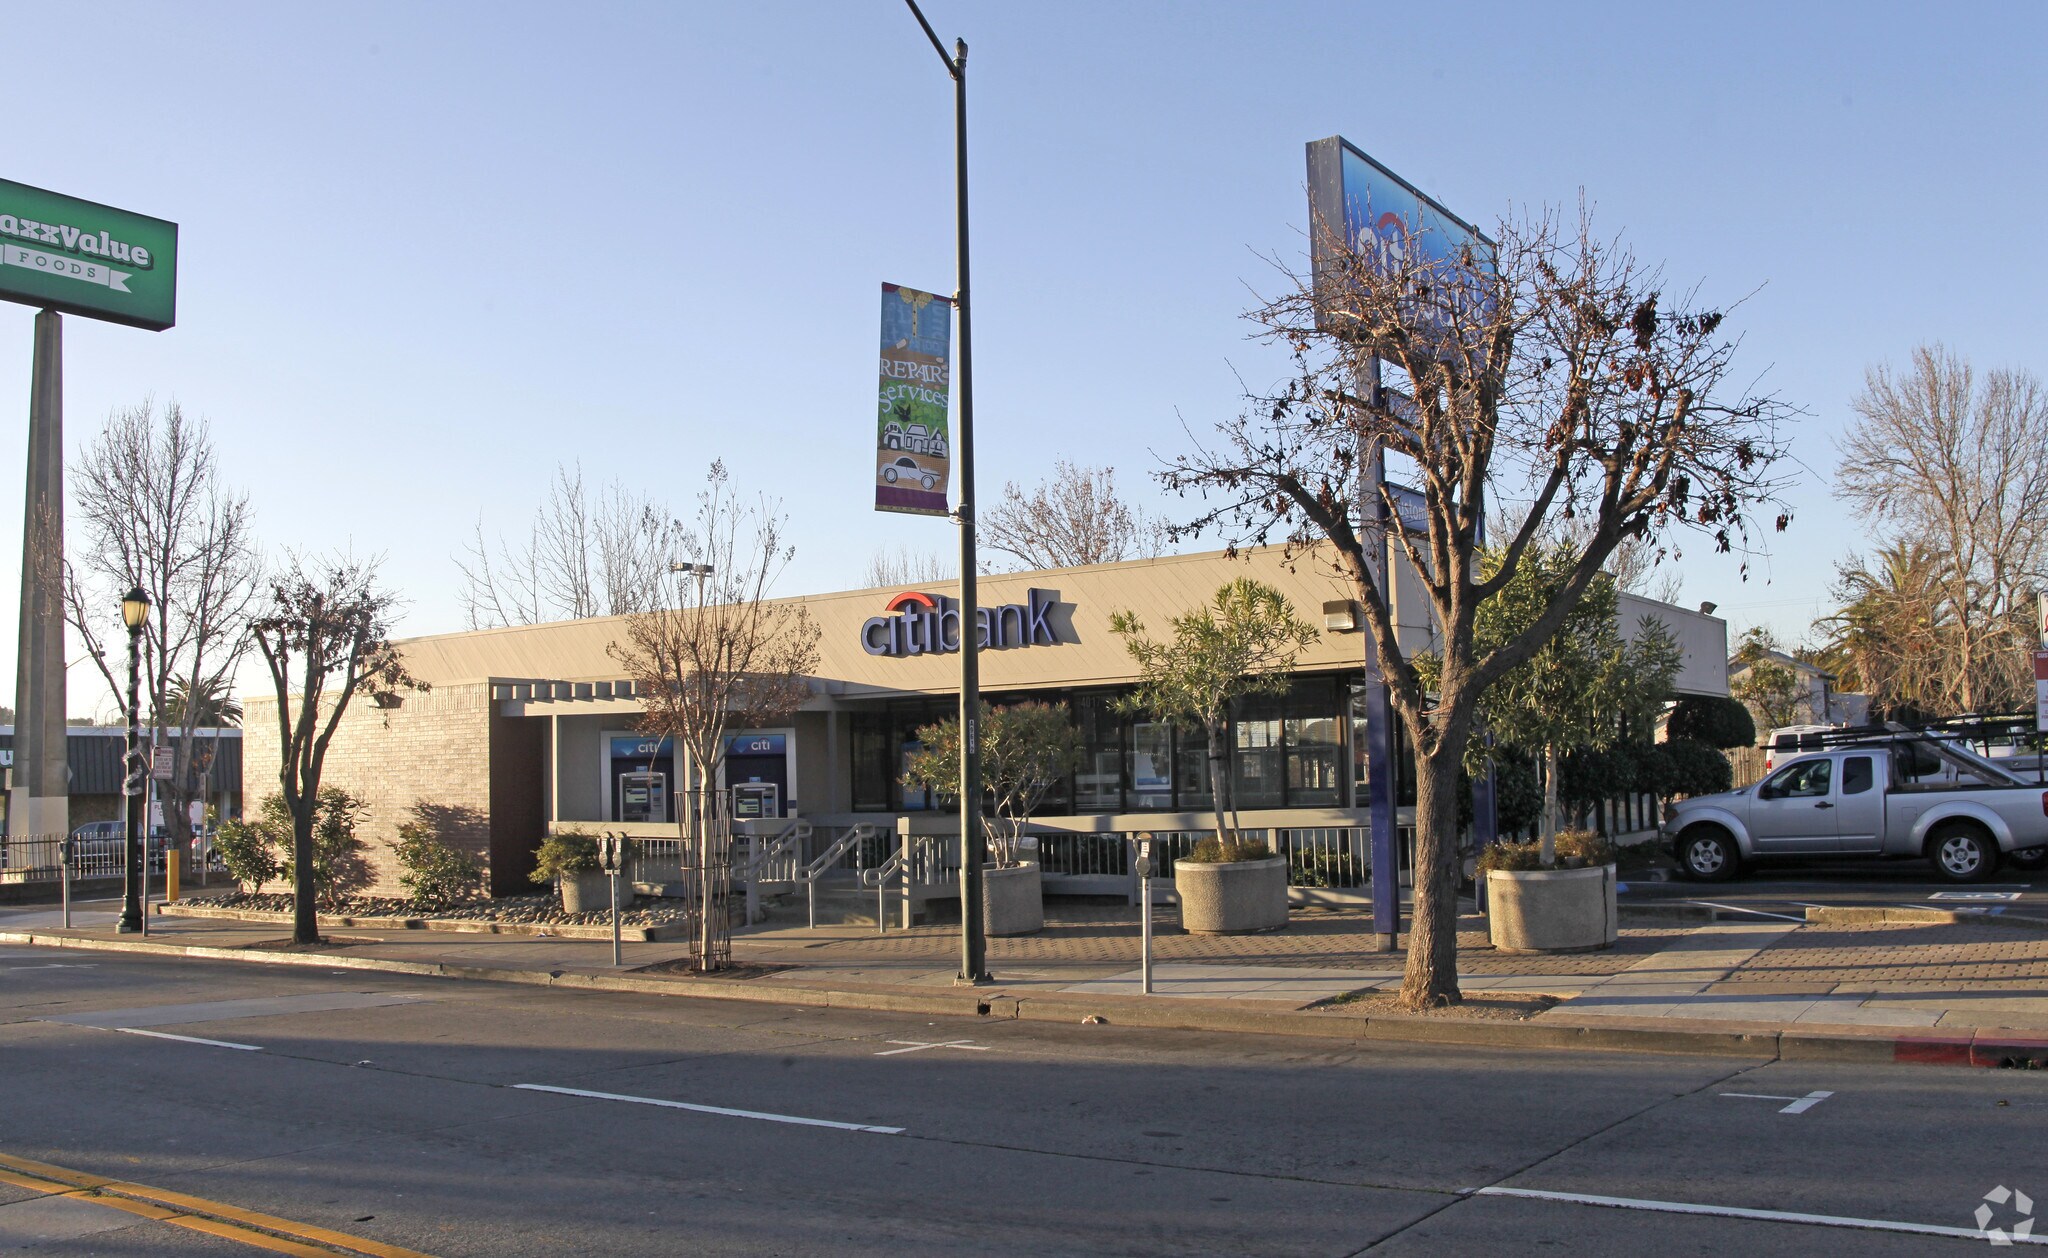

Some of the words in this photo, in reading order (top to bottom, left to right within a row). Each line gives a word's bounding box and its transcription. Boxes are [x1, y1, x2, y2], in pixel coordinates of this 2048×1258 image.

[19, 251, 96, 278] FOODS
[880, 357, 944, 384] REPAIR
[879, 383, 949, 413] Services
[861, 588, 1058, 656] citibank
[638, 741, 658, 753] citi
[751, 740, 770, 751] citi
